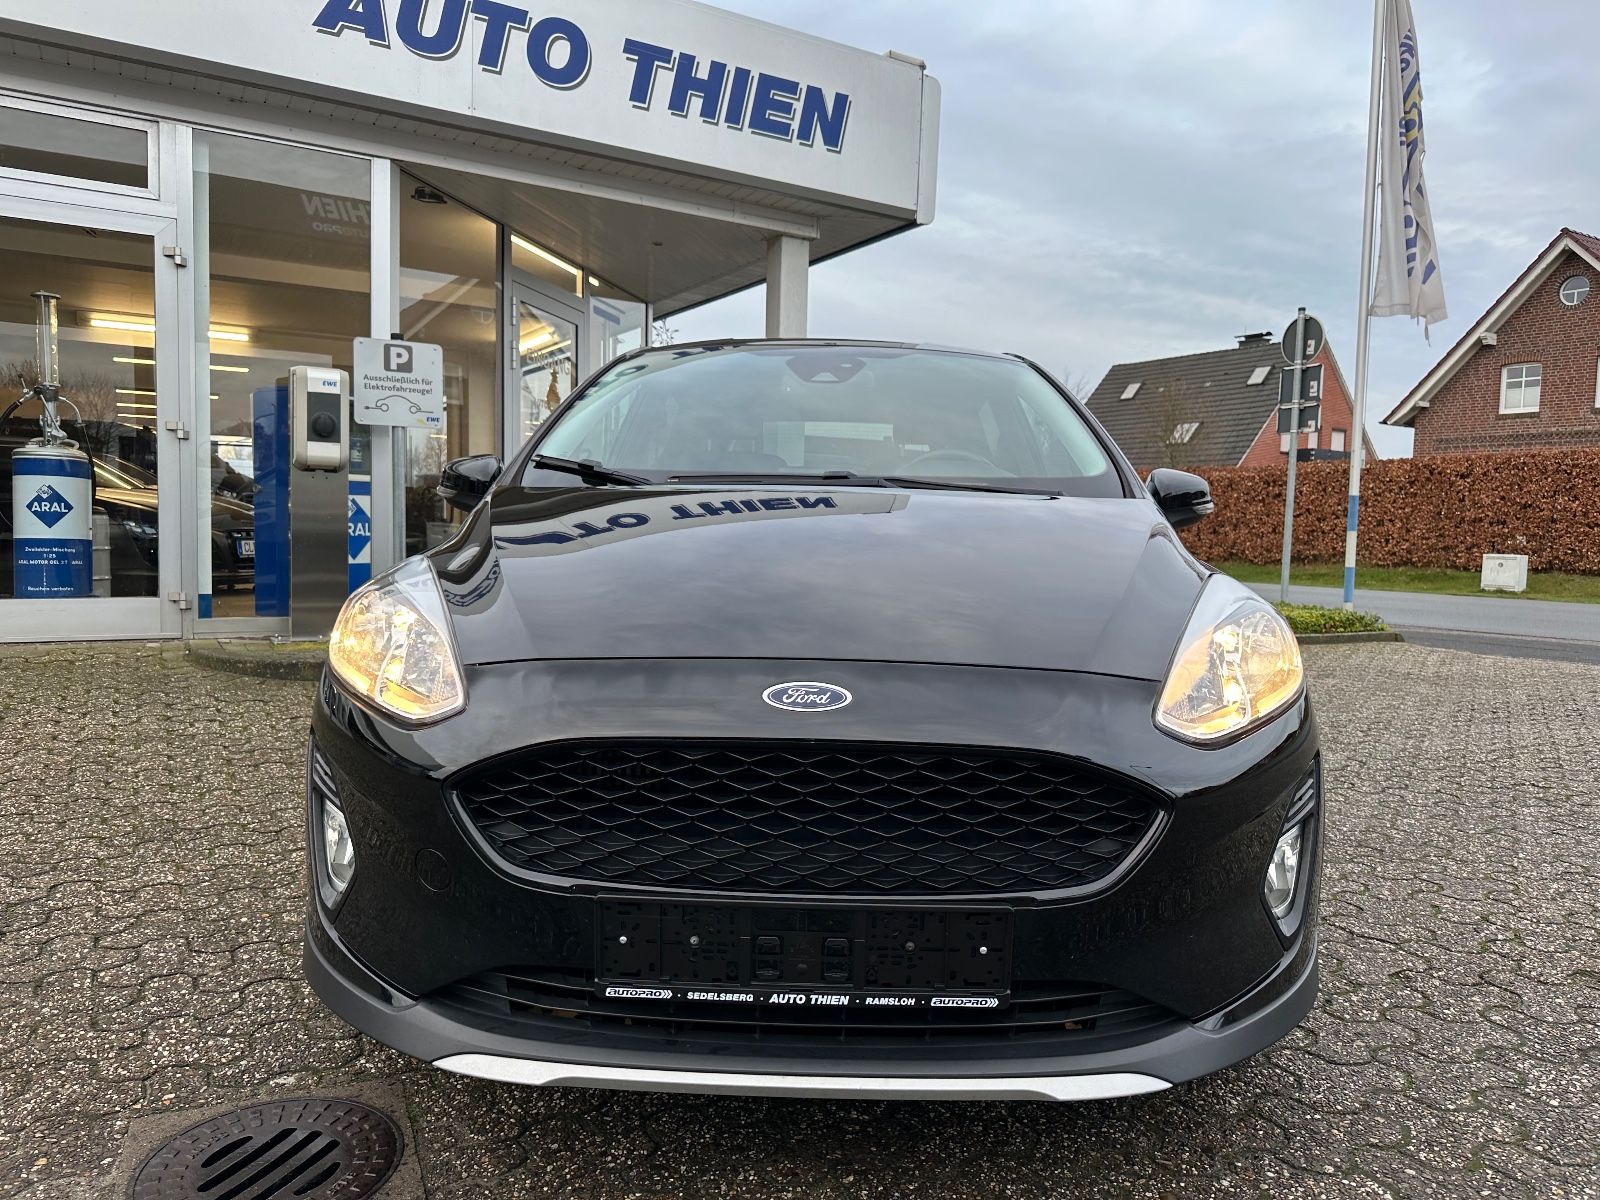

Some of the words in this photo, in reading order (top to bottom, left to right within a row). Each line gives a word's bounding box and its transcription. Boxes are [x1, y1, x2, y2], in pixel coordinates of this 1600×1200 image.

[312, 0, 592, 90] AUTO
[622, 38, 852, 154] THIEN
[322, 380, 338, 388] EWE
[363, 373, 420, 386] Ausschließlich
[421, 378, 433, 386] für
[363, 382, 433, 396] Elektrofahrzeuge!
[31, 501, 69, 513] ARAL
[347, 522, 371, 537] RAL
[782, 687, 831, 704] Ford
[686, 991, 754, 1002] SEDELSBERG
[768, 993, 806, 1004] AUTO
[809, 994, 850, 1006] THIEN
[865, 997, 916, 1006] RAMSLOH
